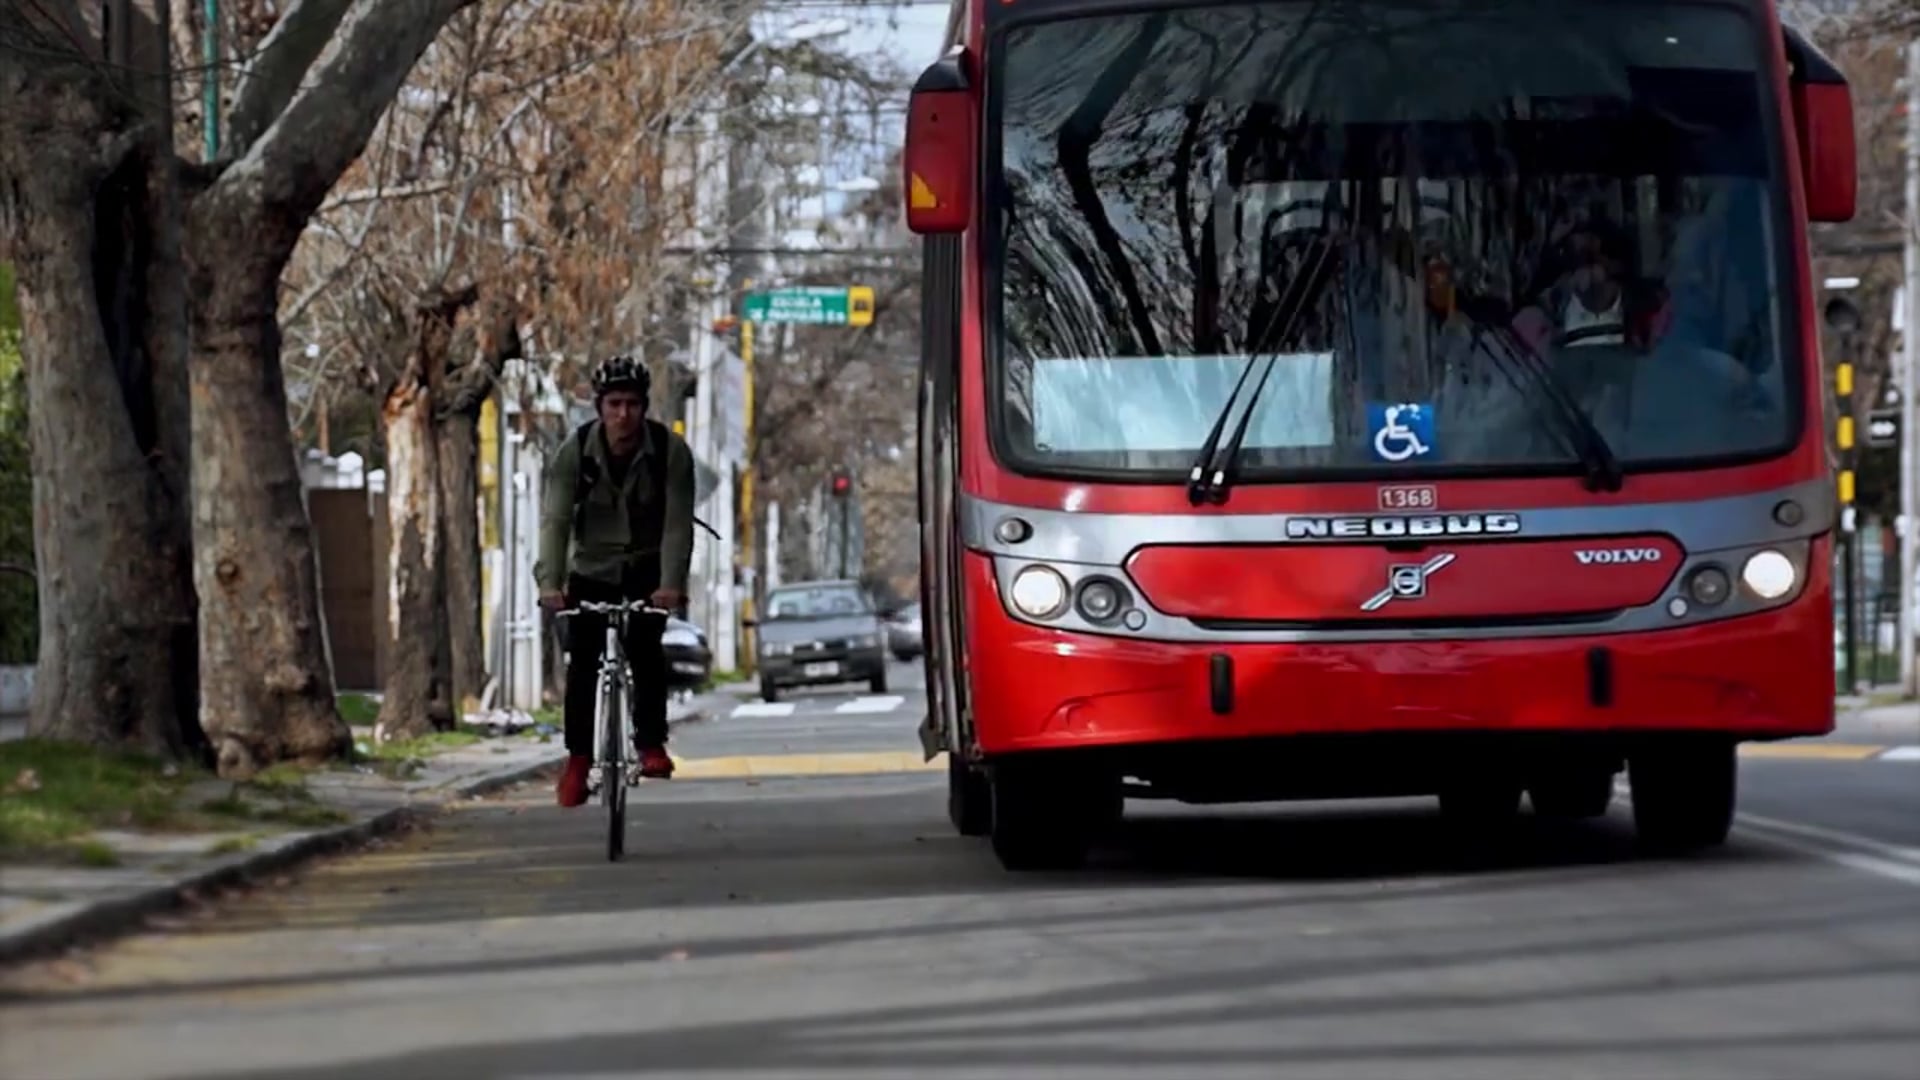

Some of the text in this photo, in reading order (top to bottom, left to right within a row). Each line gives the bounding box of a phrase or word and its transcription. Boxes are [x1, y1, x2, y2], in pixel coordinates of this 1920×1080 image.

[1384, 490, 1433, 506] 1368
[1287, 514, 1520, 537] NEOBUS
[1573, 548, 1661, 564] VOLVO
